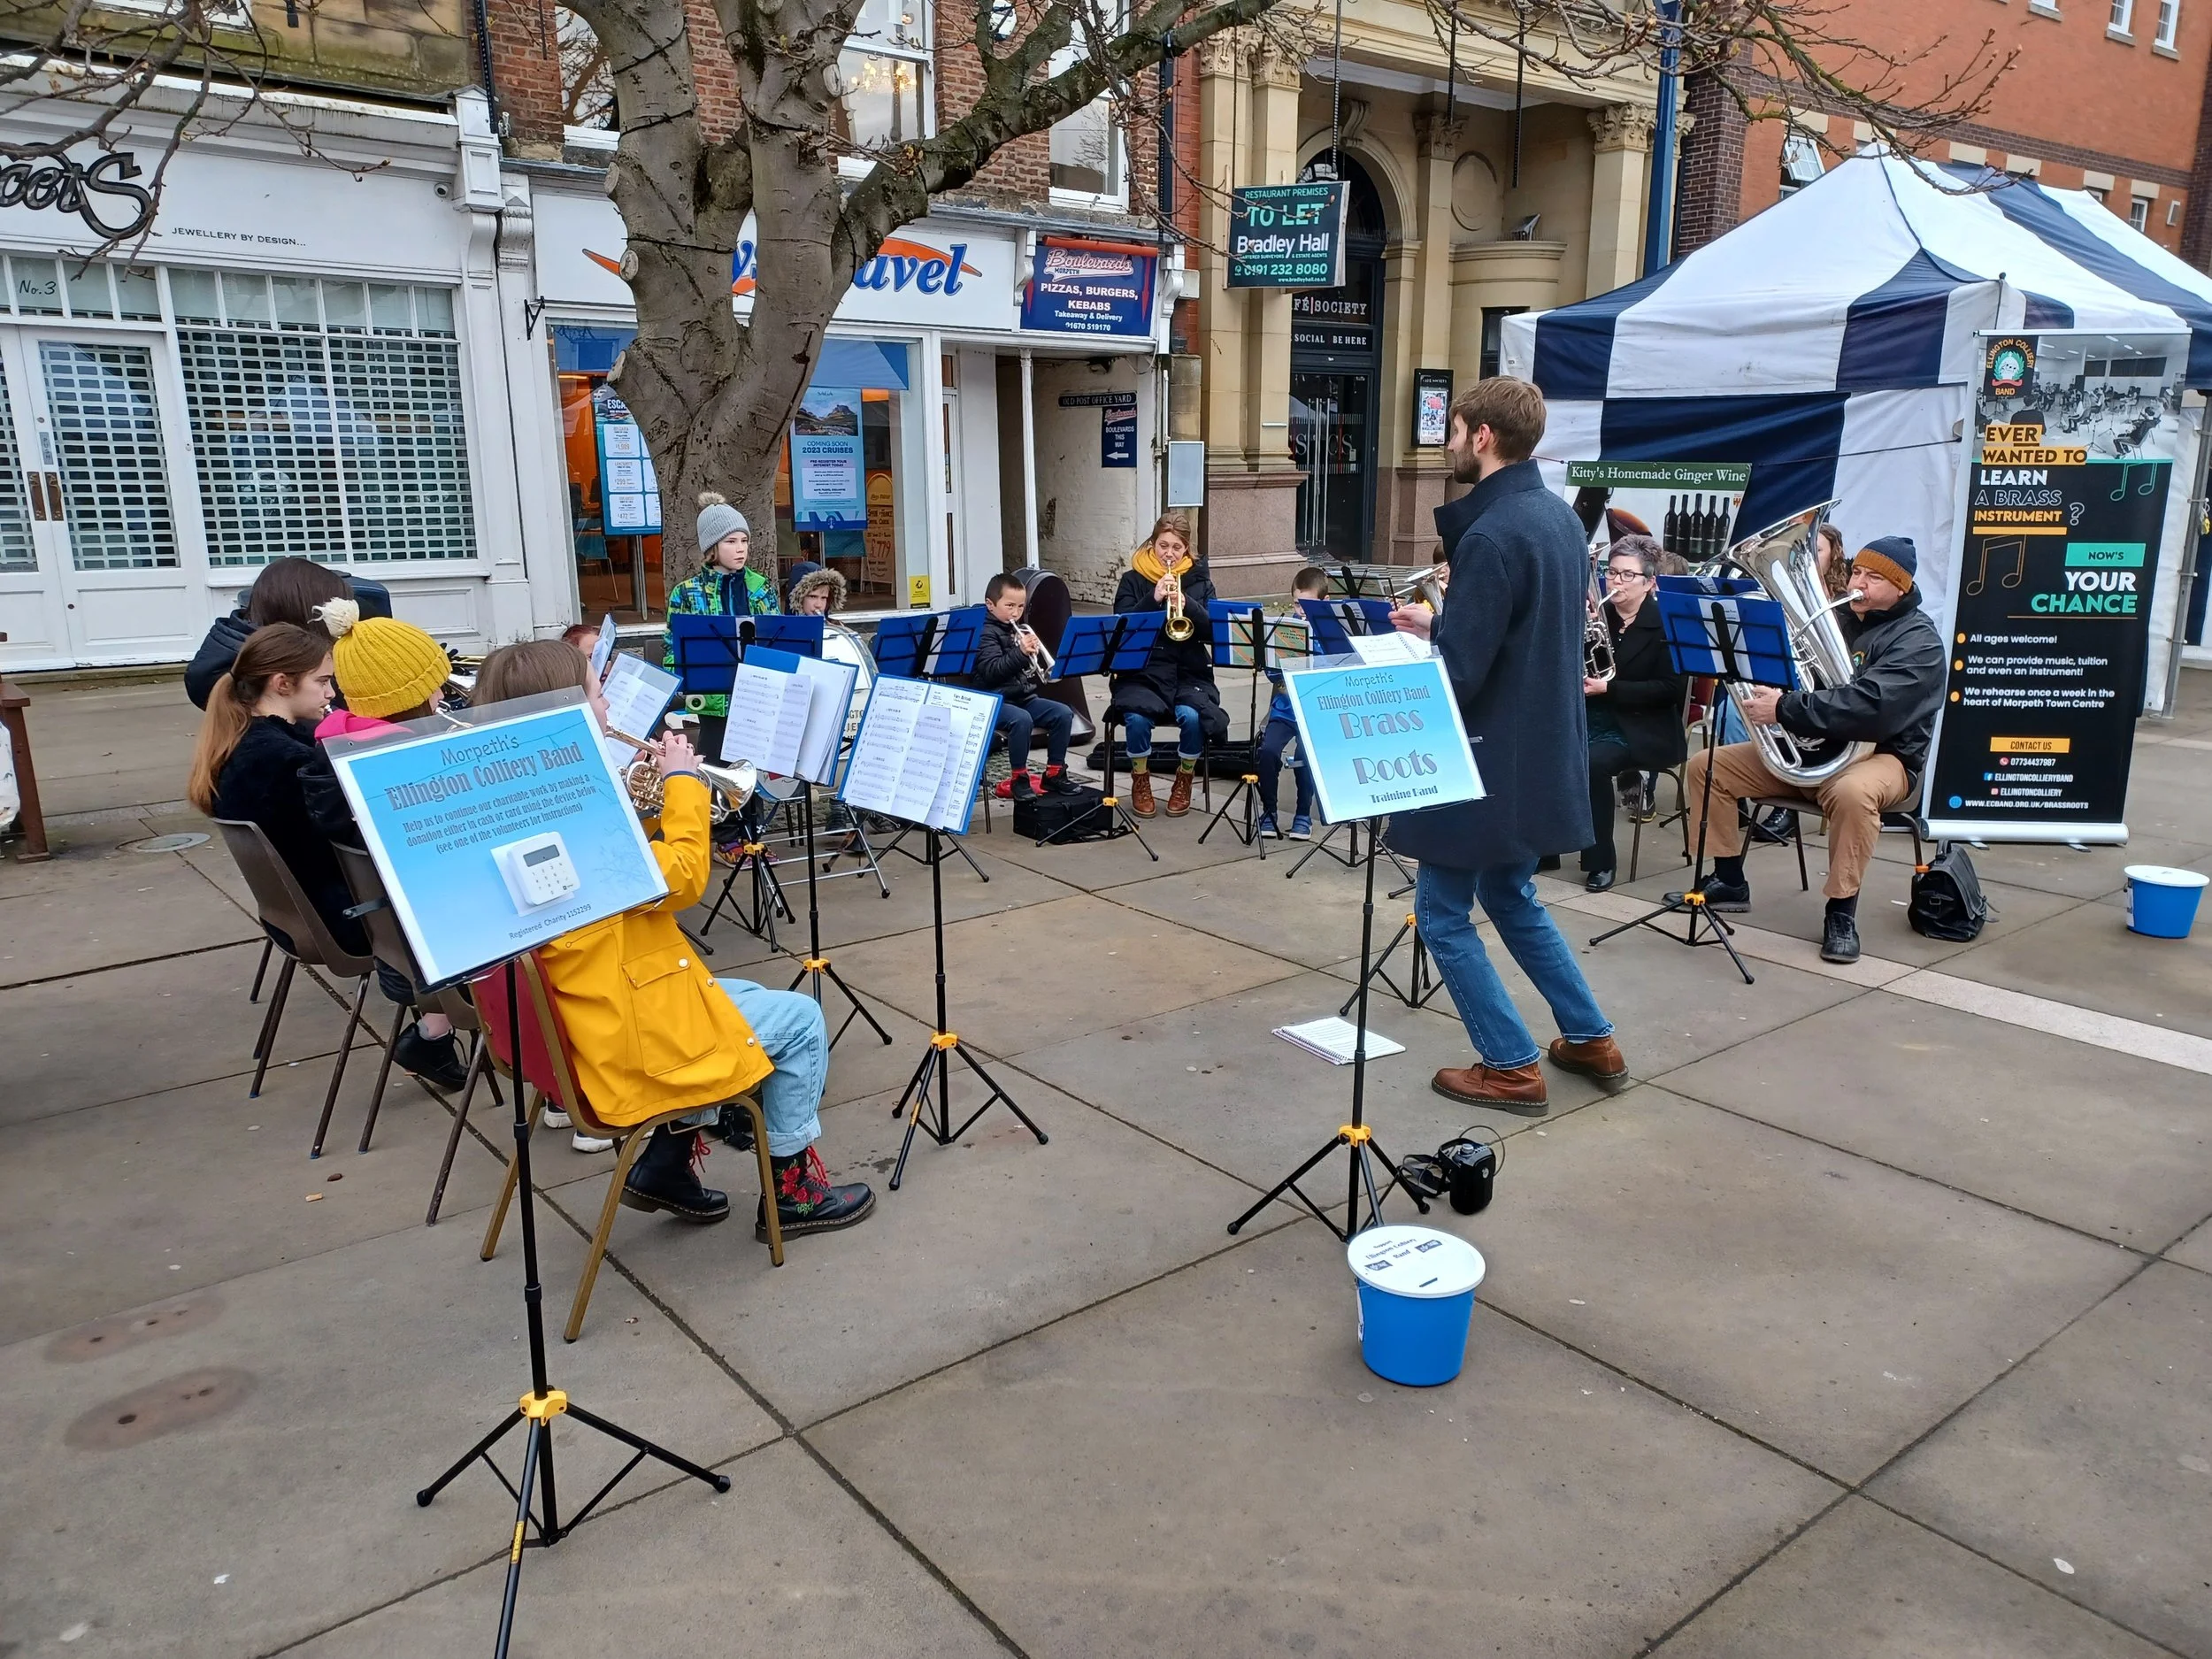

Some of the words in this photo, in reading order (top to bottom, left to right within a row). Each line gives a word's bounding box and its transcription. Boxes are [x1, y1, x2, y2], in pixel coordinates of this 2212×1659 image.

[1245, 188, 1292, 199] RESTAURANT
[1293, 187, 1329, 196] PREMISES
[1247, 205, 1275, 227] TO
[1282, 204, 1325, 226] LET
[172, 227, 237, 241] JEWELLERY
[241, 233, 254, 242] BY
[257, 235, 307, 247] DESIGN...
[1300, 233, 1330, 252] Hall
[1047, 248, 1133, 271] Boulevards
[853, 243, 968, 296] avel
[1271, 264, 1293, 275] 232
[1295, 263, 1328, 275] 8080
[1041, 282, 1083, 296] PIZZAS,
[1086, 286, 1139, 301] BURGERS,
[1068, 300, 1111, 311] KEBABS
[1294, 296, 1310, 311] FÉ
[1054, 310, 1088, 320] Takeaway
[1096, 312, 1123, 322] Delivery
[1087, 323, 1111, 332] 519170
[1294, 334, 1325, 343] SOCIAL
[1333, 335, 1343, 344] BE
[1345, 336, 1367, 345] HERE
[1986, 339, 2014, 369] ELLINGTON
[2016, 339, 2035, 369] COLLIERY
[607, 399, 626, 409] ESCA
[1092, 396, 1113, 404] OFFICE
[1114, 394, 1132, 403] YARD
[1985, 426, 2038, 442] EVER
[1983, 449, 2057, 463] WANTED
[2064, 449, 2088, 463] TO
[1571, 466, 1605, 481] Kitty's
[1607, 467, 1671, 480] Homemade
[1674, 468, 1714, 485] Ginger
[1717, 469, 1747, 482] Wine
[1980, 469, 2048, 486] LEARN
[1974, 489, 1989, 505] A
[1994, 489, 2062, 506] BRASS
[1974, 511, 2062, 522] INSTRUMENT
[2069, 502, 2085, 526] ?
[2088, 551, 2124, 560] NOW'S
[2065, 571, 2137, 591] YOUR
[2031, 594, 2139, 613] CHANCE
[1970, 634, 1982, 643] All
[1984, 635, 2009, 645] ages
[2010, 635, 2058, 644] welcome!
[2006, 656, 2044, 666] provide
[2045, 657, 2077, 666] music,
[2078, 657, 2108, 665] tuition
[1966, 666, 1986, 675] and
[2029, 667, 2084, 676] instrument!
[1344, 672, 1394, 688] Morpeth's
[1317, 694, 1364, 710] Ellington
[1364, 688, 1402, 704] Colliery
[1402, 685, 1431, 701] Band
[1964, 687, 1981, 695] We
[1982, 687, 2026, 696] rehearse
[2027, 688, 2052, 697] once
[2061, 688, 2086, 697] week
[2087, 688, 2097, 697] in
[1962, 697, 1990, 706] heart
[2003, 699, 2044, 709] Morpeth
[2045, 699, 2071, 708] Town
[1339, 709, 1425, 740] Brass
[441, 734, 520, 765] Morpeth's
[2009, 741, 2041, 750] CONTACT
[2042, 741, 2053, 750] US
[1352, 749, 1438, 785] Roots
[384, 772, 473, 811] Ellington
[472, 755, 538, 787] Colliery
[537, 741, 585, 771] Band
[1994, 772, 2074, 783] ELLINGTONCOLLIERYBAND
[1370, 790, 1412, 803] Training
[1412, 785, 1439, 797] Band
[2000, 787, 2062, 796] ELLINGTONCOLLIERY
[403, 819, 424, 833] Help
[425, 816, 434, 825] us
[434, 814, 444, 825] to
[444, 804, 479, 822] continue
[478, 801, 492, 810] our
[492, 790, 530, 808] charitable
[529, 785, 549, 797] work
[549, 781, 559, 793] by
[558, 775, 586, 790] making
[1964, 799, 2089, 809] WWW.ECBAND.ORG.UK/BRASSROOTS
[406, 829, 443, 847] donation
[443, 822, 467, 836] either
[467, 819, 478, 830] in
[477, 812, 495, 826] cash
[495, 812, 504, 822] or
[504, 806, 522, 819] card
[522, 801, 542, 814] using
[541, 796, 555, 808] the
[555, 790, 576, 805] device
[575, 785, 596, 798] below
[436, 840, 454, 855] (see
[454, 836, 470, 849] one
[469, 833, 479, 843] of
[479, 828, 493, 841] the
[492, 818, 531, 837] volunteers
[530, 815, 541, 826] for
[541, 803, 584, 822] instructions)
[509, 921, 542, 940] Registered
[543, 913, 567, 926] Charity
[1393, 1248, 1411, 1259] Band
